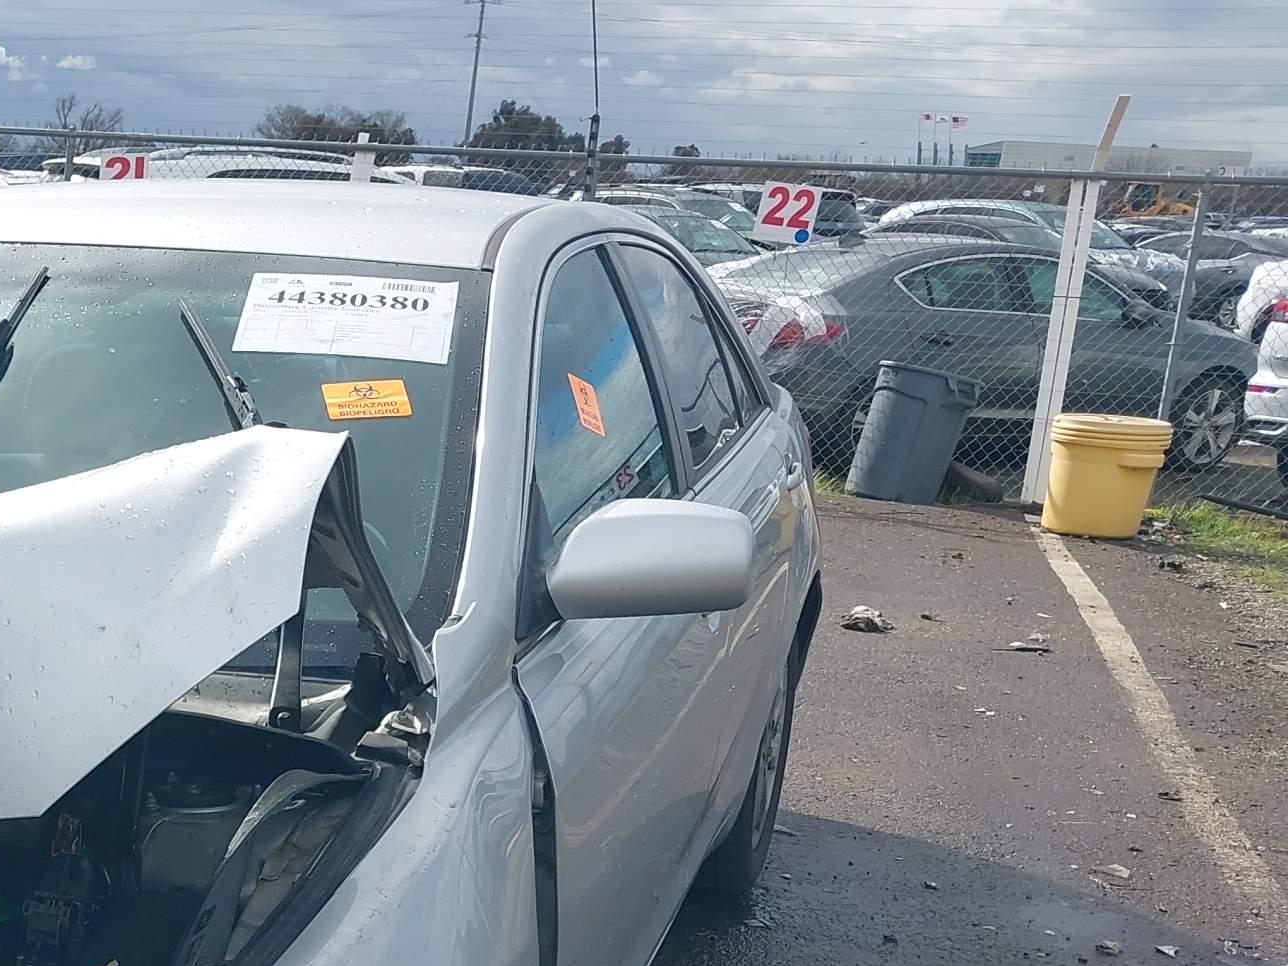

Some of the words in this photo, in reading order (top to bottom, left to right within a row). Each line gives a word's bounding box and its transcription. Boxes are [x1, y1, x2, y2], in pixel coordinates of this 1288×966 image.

[104, 156, 146, 180] 21
[761, 186, 816, 230] 22
[268, 289, 430, 312] 44380380
[337, 401, 398, 410] BIOHAZARD
[339, 408, 400, 417] BIOPELIGRO
